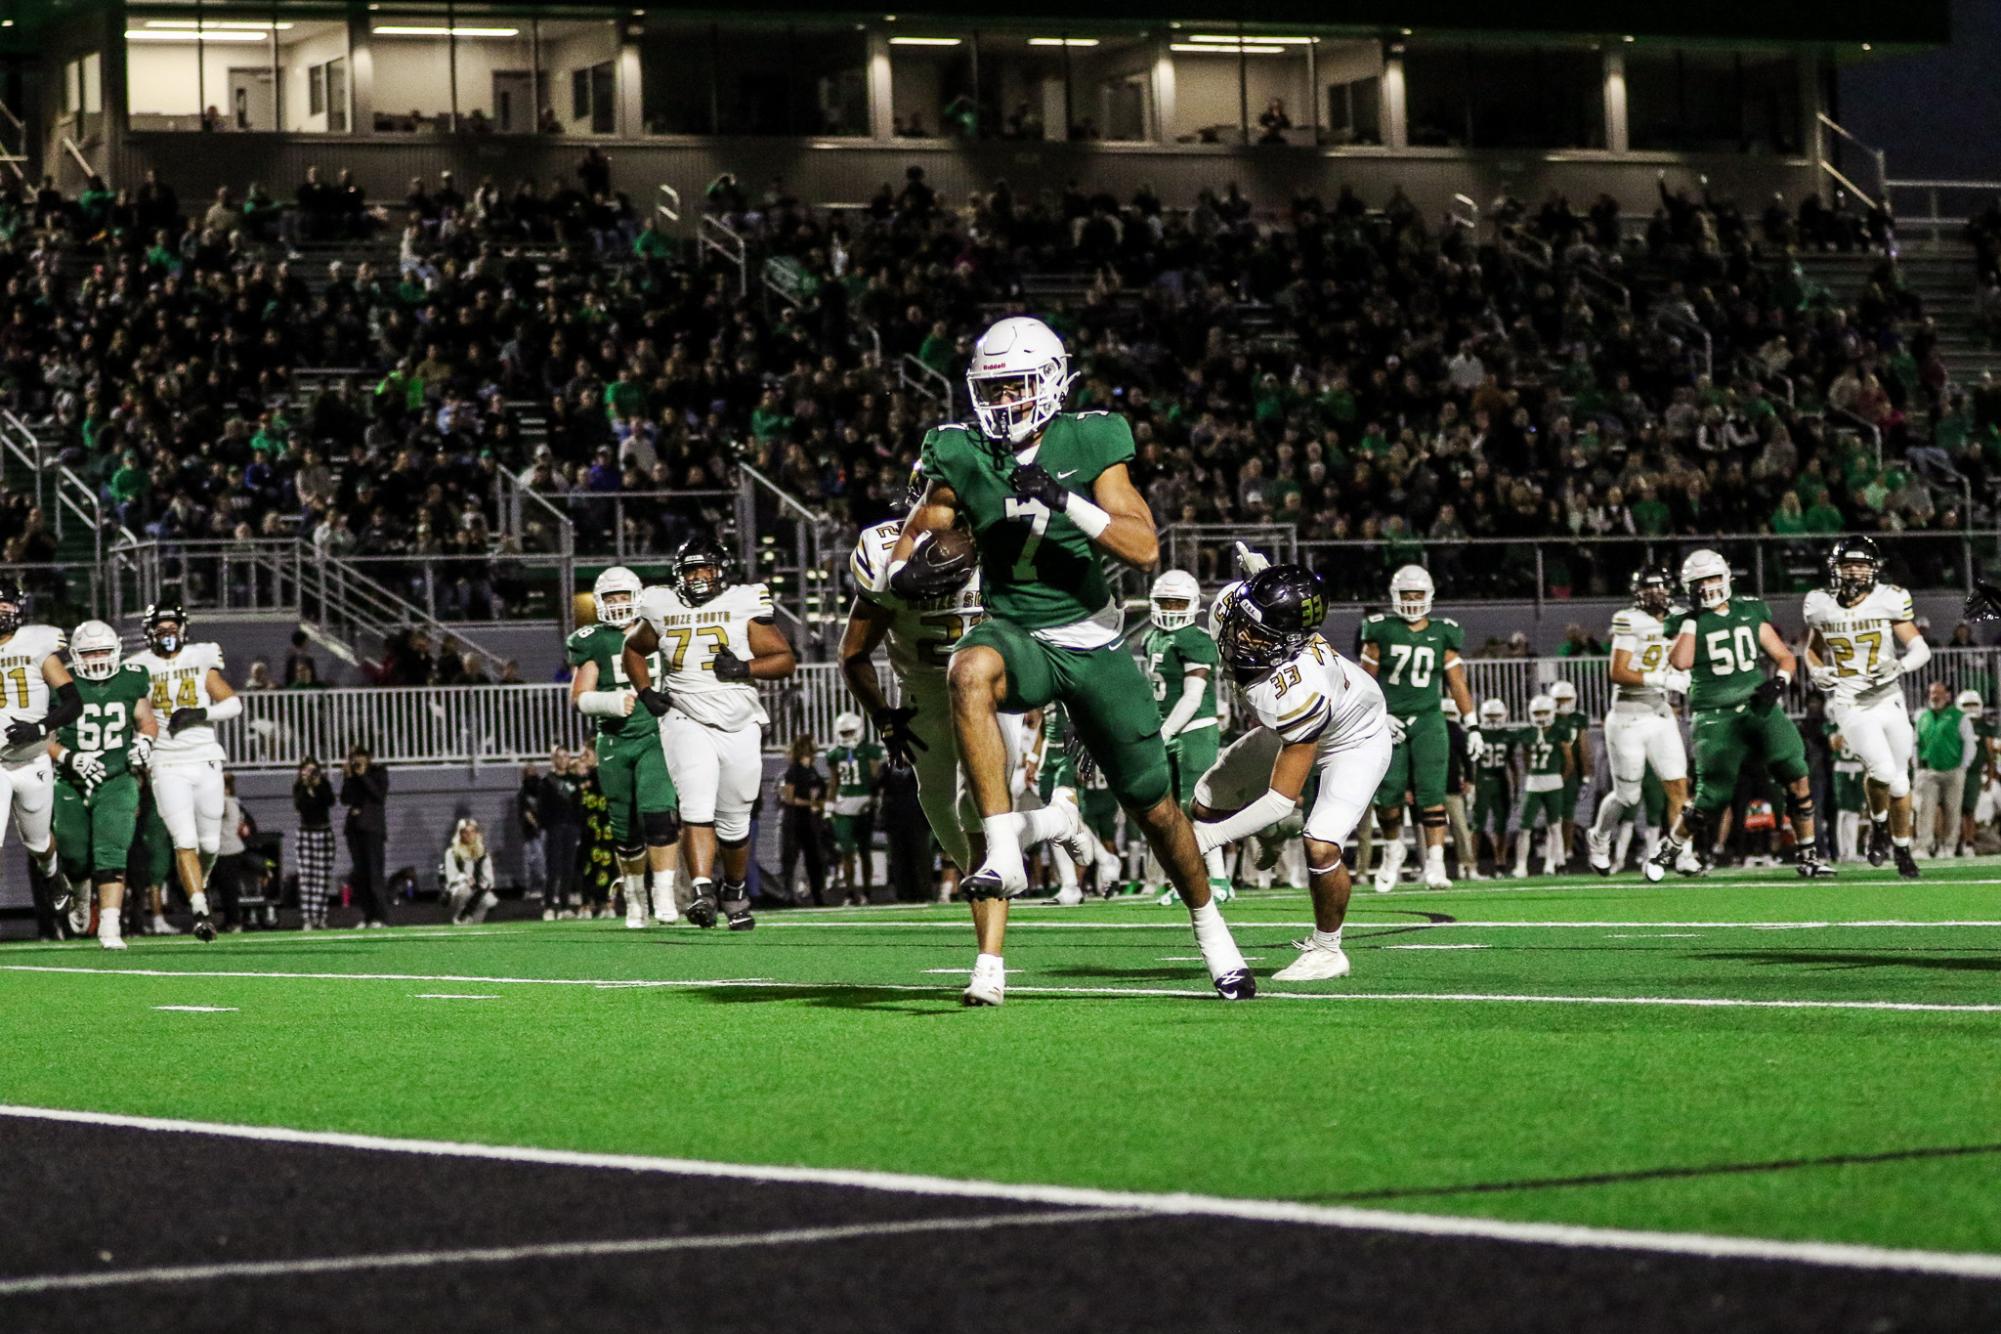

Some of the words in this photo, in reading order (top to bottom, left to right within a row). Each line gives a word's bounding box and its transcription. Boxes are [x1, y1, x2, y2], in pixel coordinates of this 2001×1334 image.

[983, 361, 1006, 371] Riddell
[1004, 496, 1051, 581] 7
[1301, 593, 1324, 628] 33
[666, 625, 729, 672] 73
[1388, 643, 1435, 688] 70
[1705, 625, 1757, 676] 50
[1827, 631, 1882, 677] 27
[151, 676, 200, 718] 44
[1270, 664, 1303, 700] 33
[77, 701, 126, 751] 62
